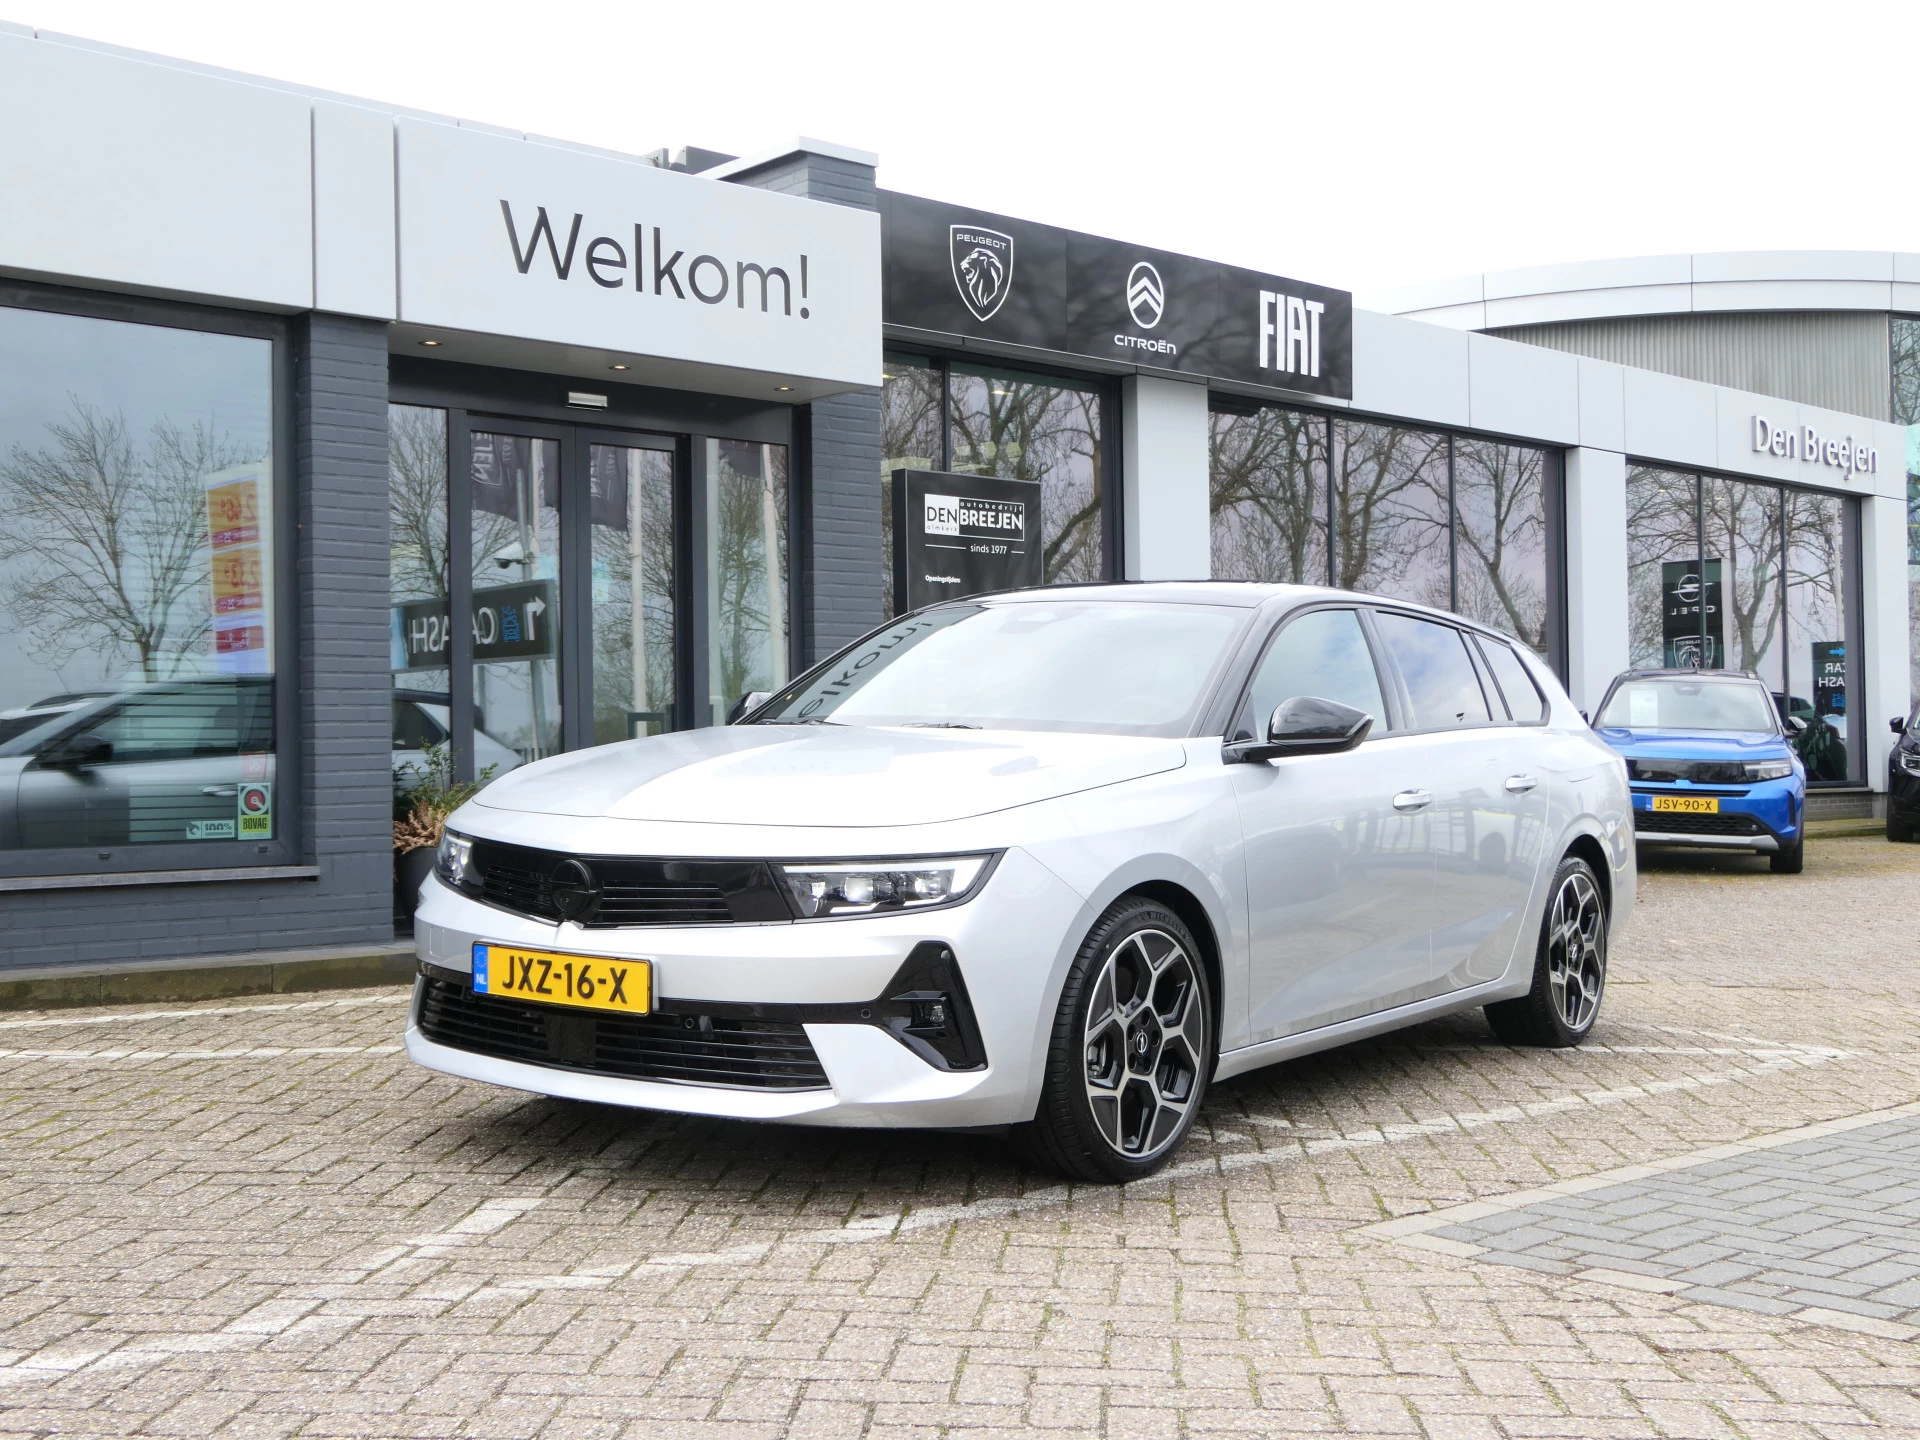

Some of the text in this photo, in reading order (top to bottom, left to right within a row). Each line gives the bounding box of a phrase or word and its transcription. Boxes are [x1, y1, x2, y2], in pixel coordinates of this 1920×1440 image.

[956, 233, 1007, 250] PEUGEOT
[499, 199, 810, 319] Welkom!
[1259, 289, 1325, 378] FIAT
[1114, 334, 1177, 355] CITROËN
[1751, 414, 1879, 480] Den Breejen
[960, 502, 1022, 512] autobedrijf
[927, 507, 1022, 530] DEN BREEJEN
[970, 544, 1007, 554] sinds 1977
[1656, 798, 1712, 811] JSV-90-X
[243, 818, 267, 829] BOVAG
[475, 973, 487, 985] NL
[502, 955, 628, 1004] JXZ-16-X
